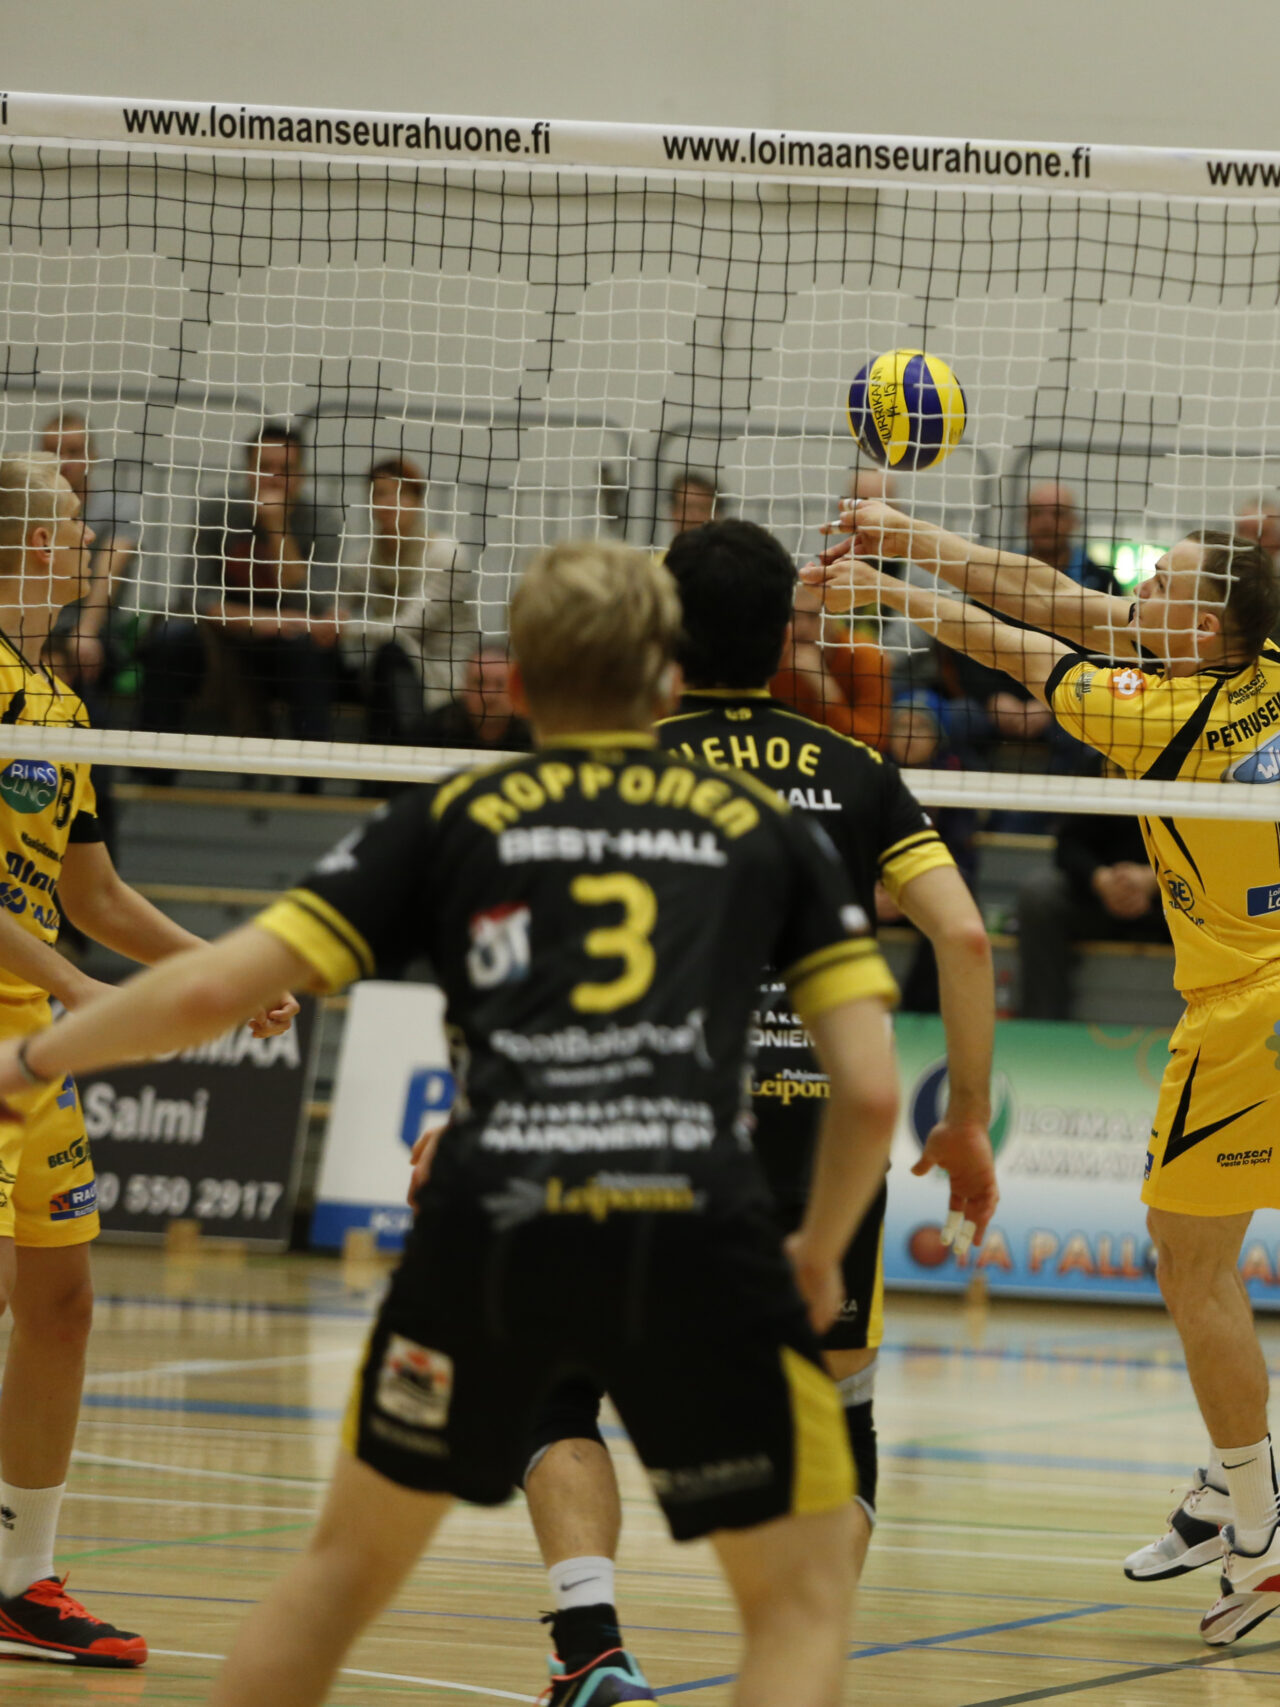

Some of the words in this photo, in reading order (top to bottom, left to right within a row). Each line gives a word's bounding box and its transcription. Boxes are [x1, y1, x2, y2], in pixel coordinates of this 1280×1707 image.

[124, 106, 550, 154] www.loimaanseurahuone.fi
[663, 133, 1091, 179] www.loimaanseurahuone.fi
[499, 826, 728, 867] BEST-HALL
[570, 871, 659, 1012] 3
[83, 1081, 210, 1144] Salmi
[1217, 1147, 1272, 1163] panzeri
[125, 1174, 191, 1216] 550
[195, 1177, 284, 1222] 2917
